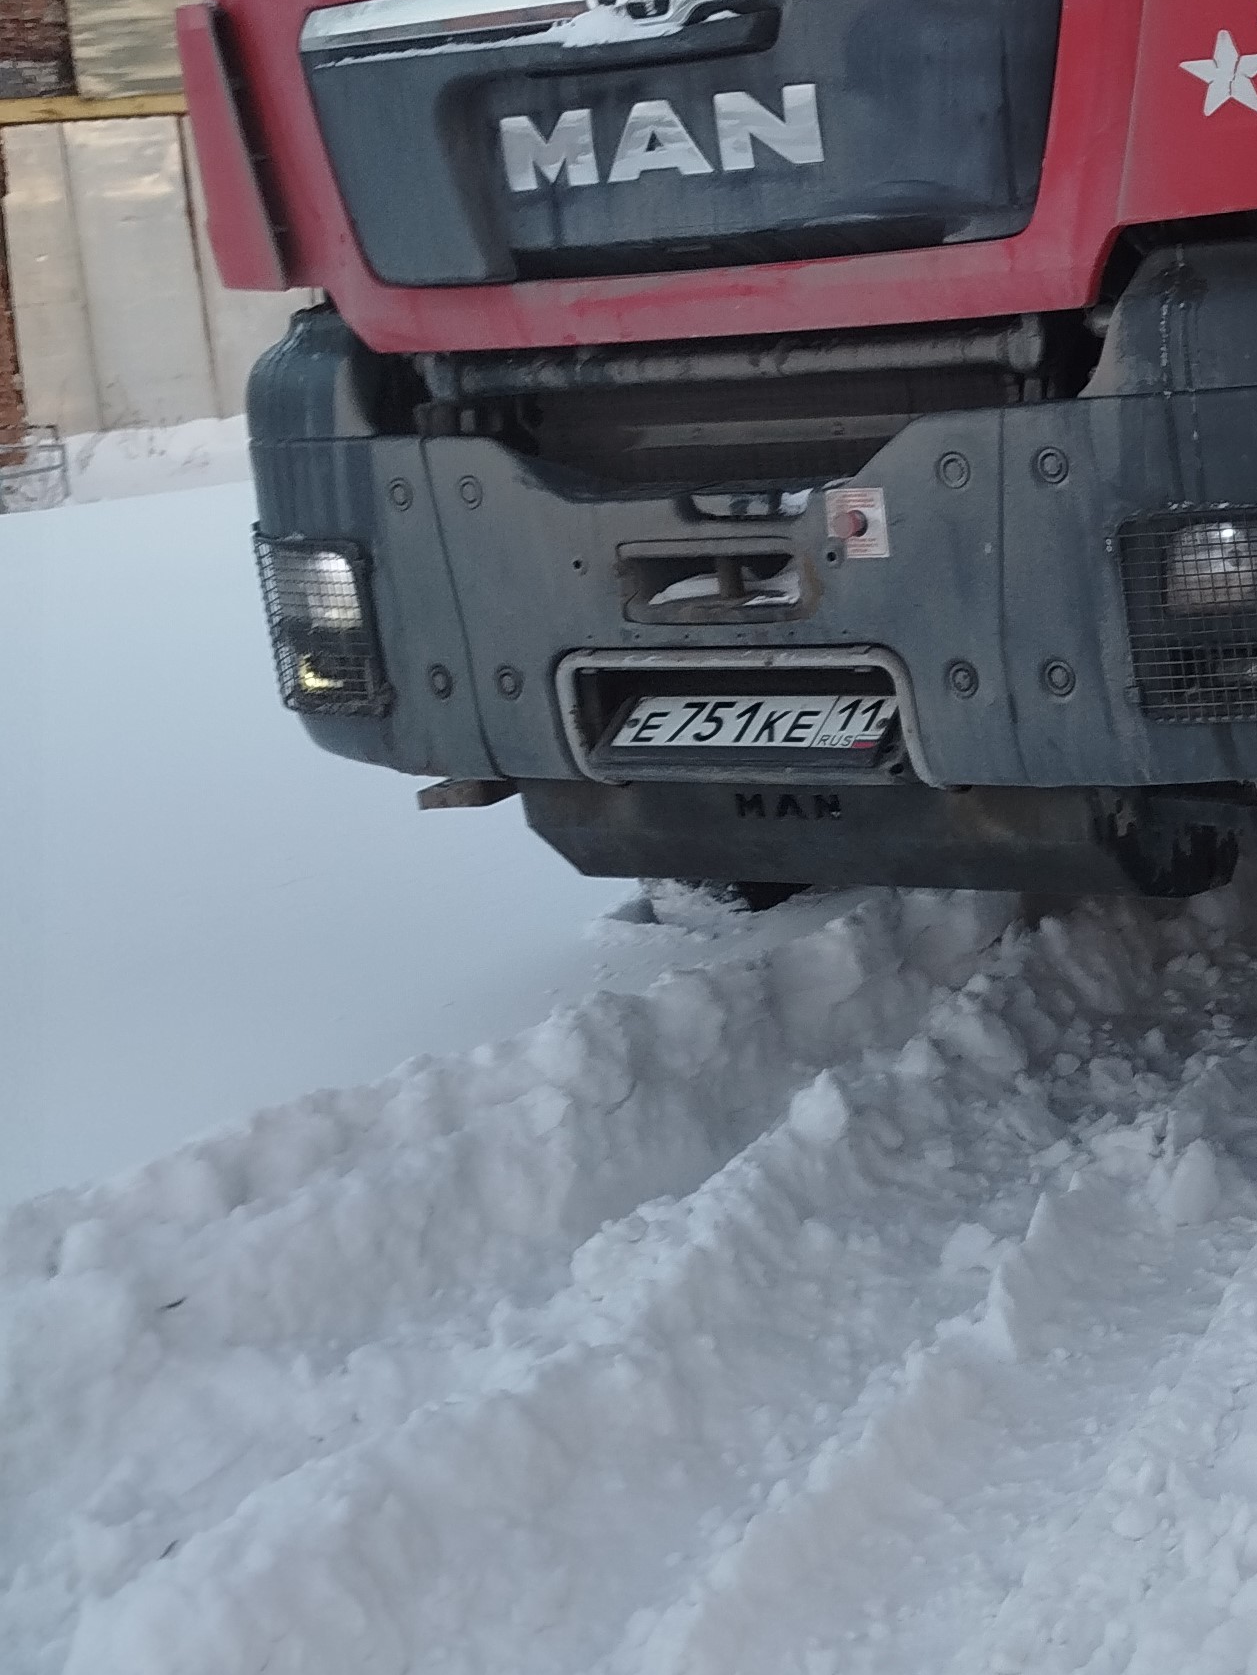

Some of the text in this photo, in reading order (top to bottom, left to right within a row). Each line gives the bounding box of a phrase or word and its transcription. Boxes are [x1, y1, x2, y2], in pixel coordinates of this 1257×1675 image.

[500, 83, 825, 192] MAN
[817, 734, 853, 747] RUS
[735, 793, 842, 821] MAN
